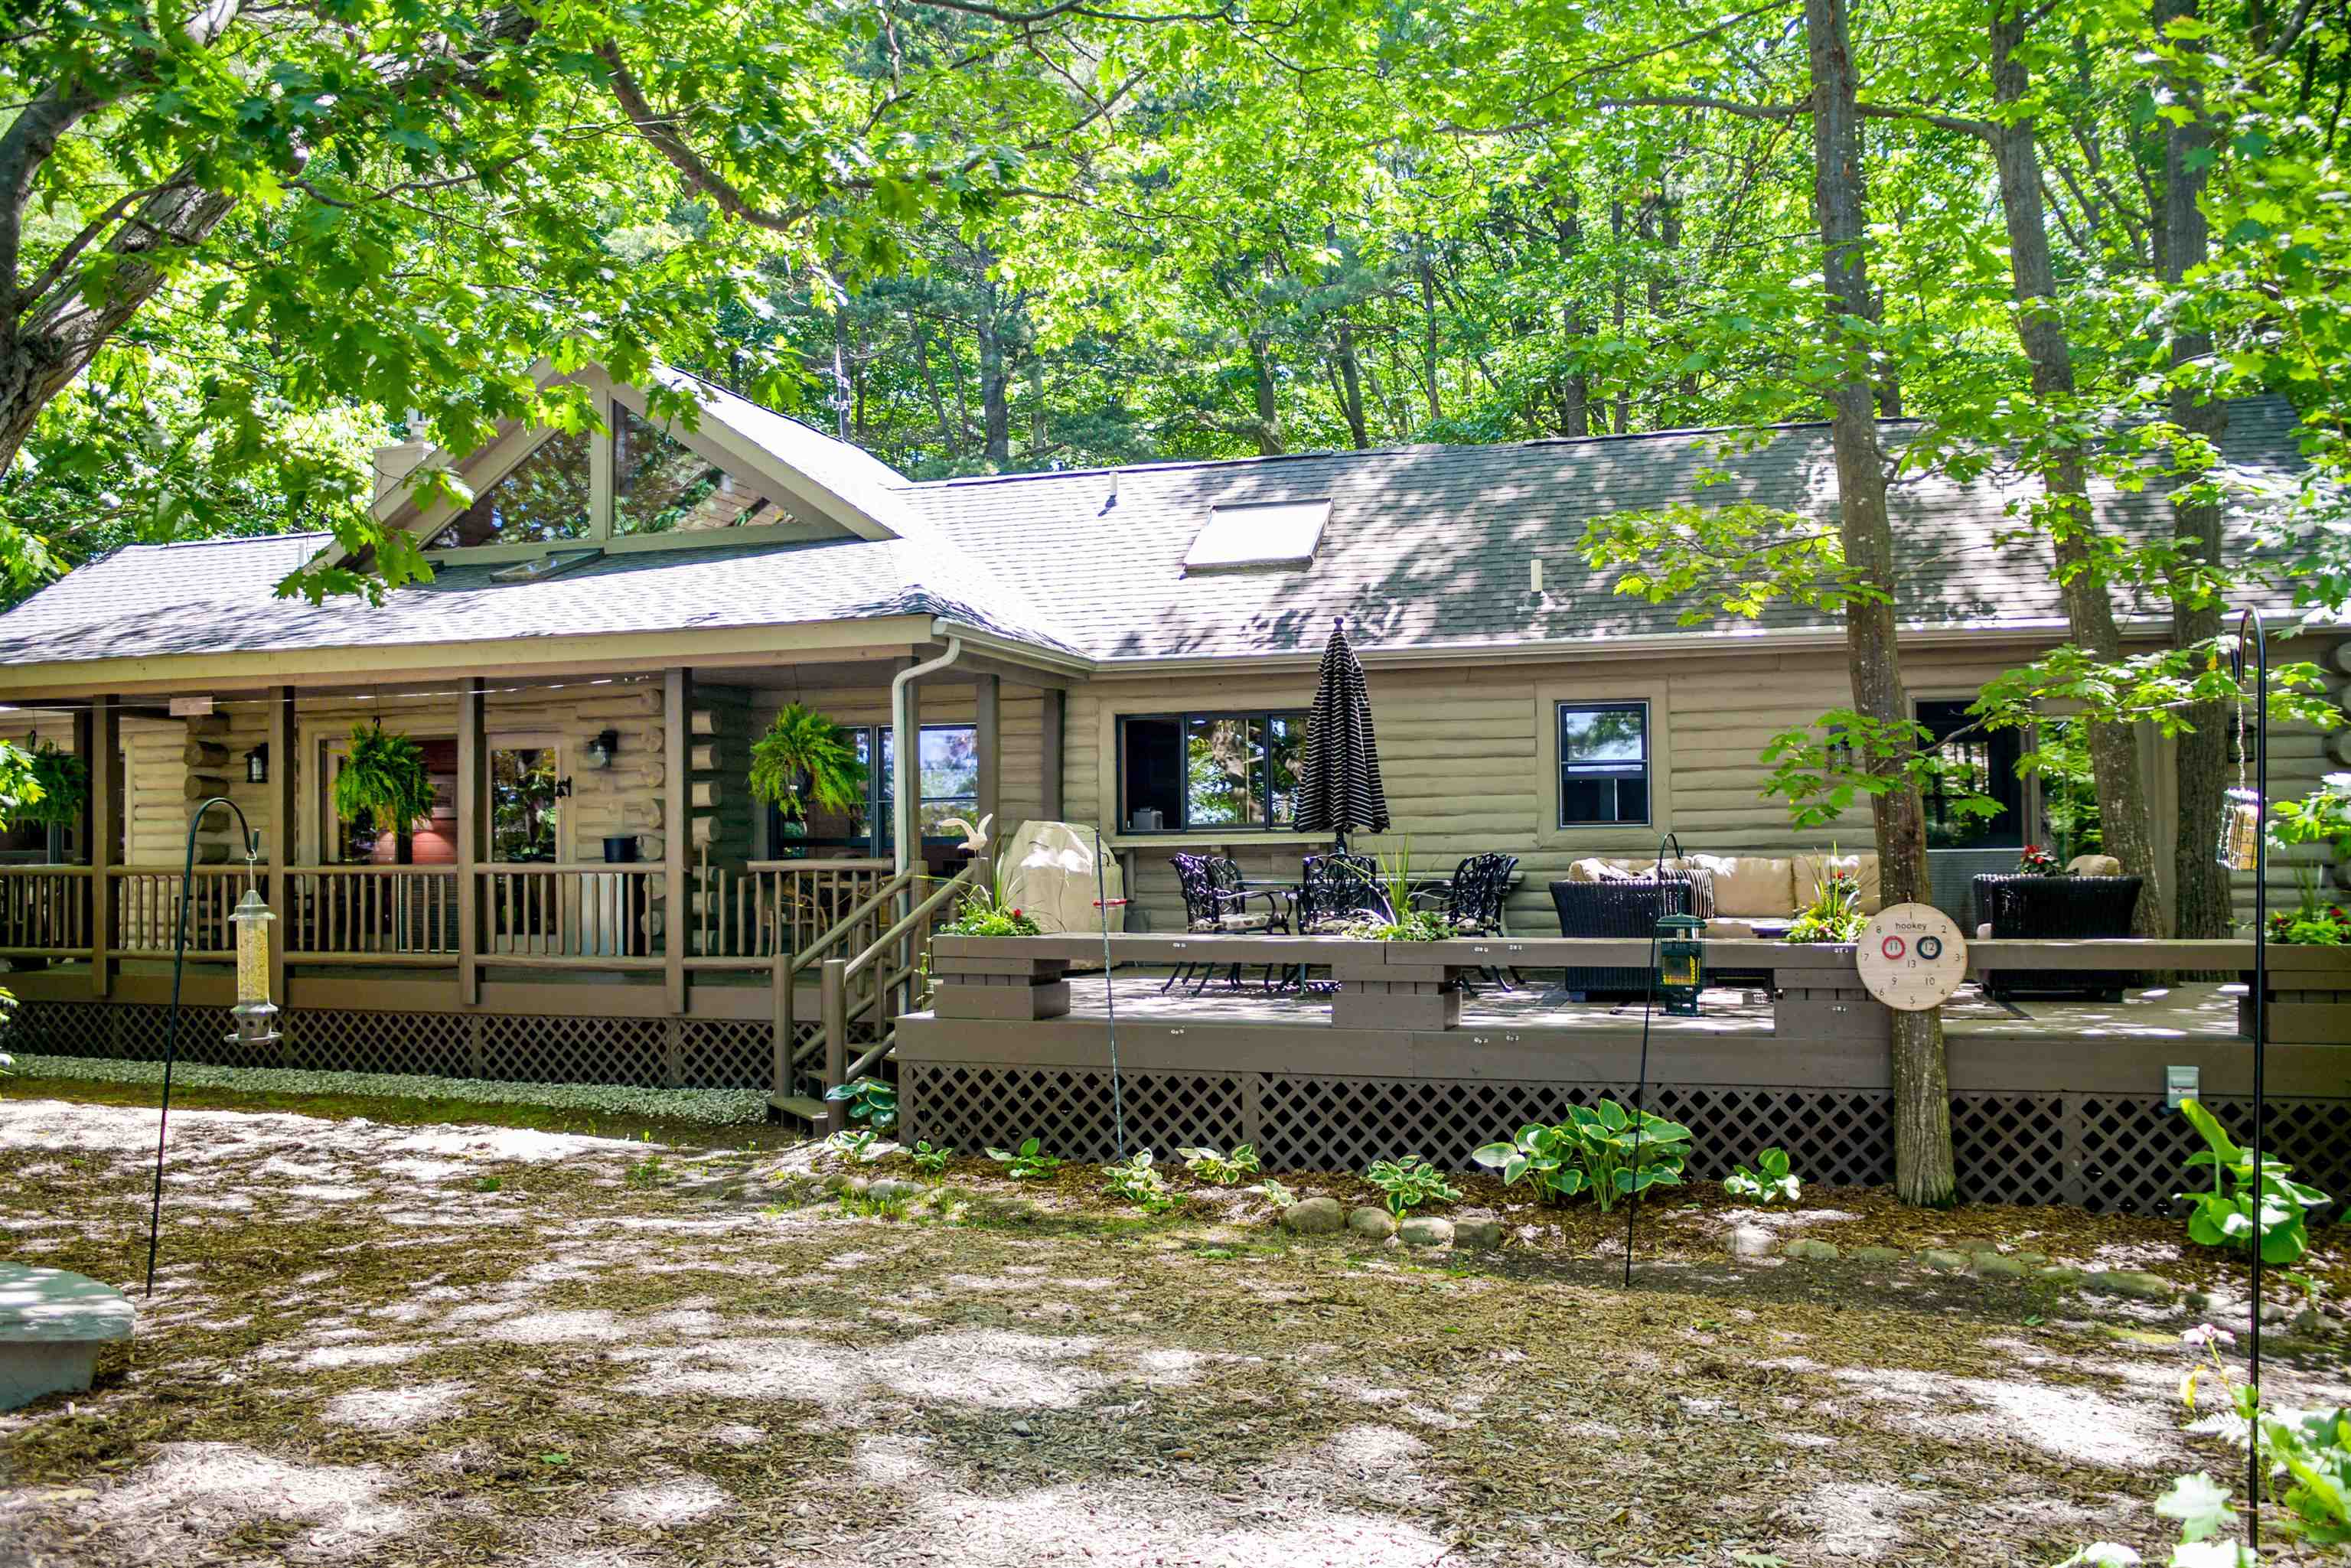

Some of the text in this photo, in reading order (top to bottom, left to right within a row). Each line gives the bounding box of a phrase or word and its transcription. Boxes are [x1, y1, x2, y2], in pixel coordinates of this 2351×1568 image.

[1876, 924, 1881, 934] 8
[1895, 921, 1927, 931] hookey
[1941, 924, 1947, 934] 2
[1890, 942, 1898, 951] 11
[1924, 942, 1935, 951] 12
[1864, 953, 1870, 962] 7
[1954, 953, 1960, 962] 3
[1907, 959, 1916, 968] 13
[1891, 976, 1897, 986] 9
[1925, 976, 1935, 986] 10
[1879, 988, 1885, 996] 6
[1909, 996, 1916, 1005] 5
